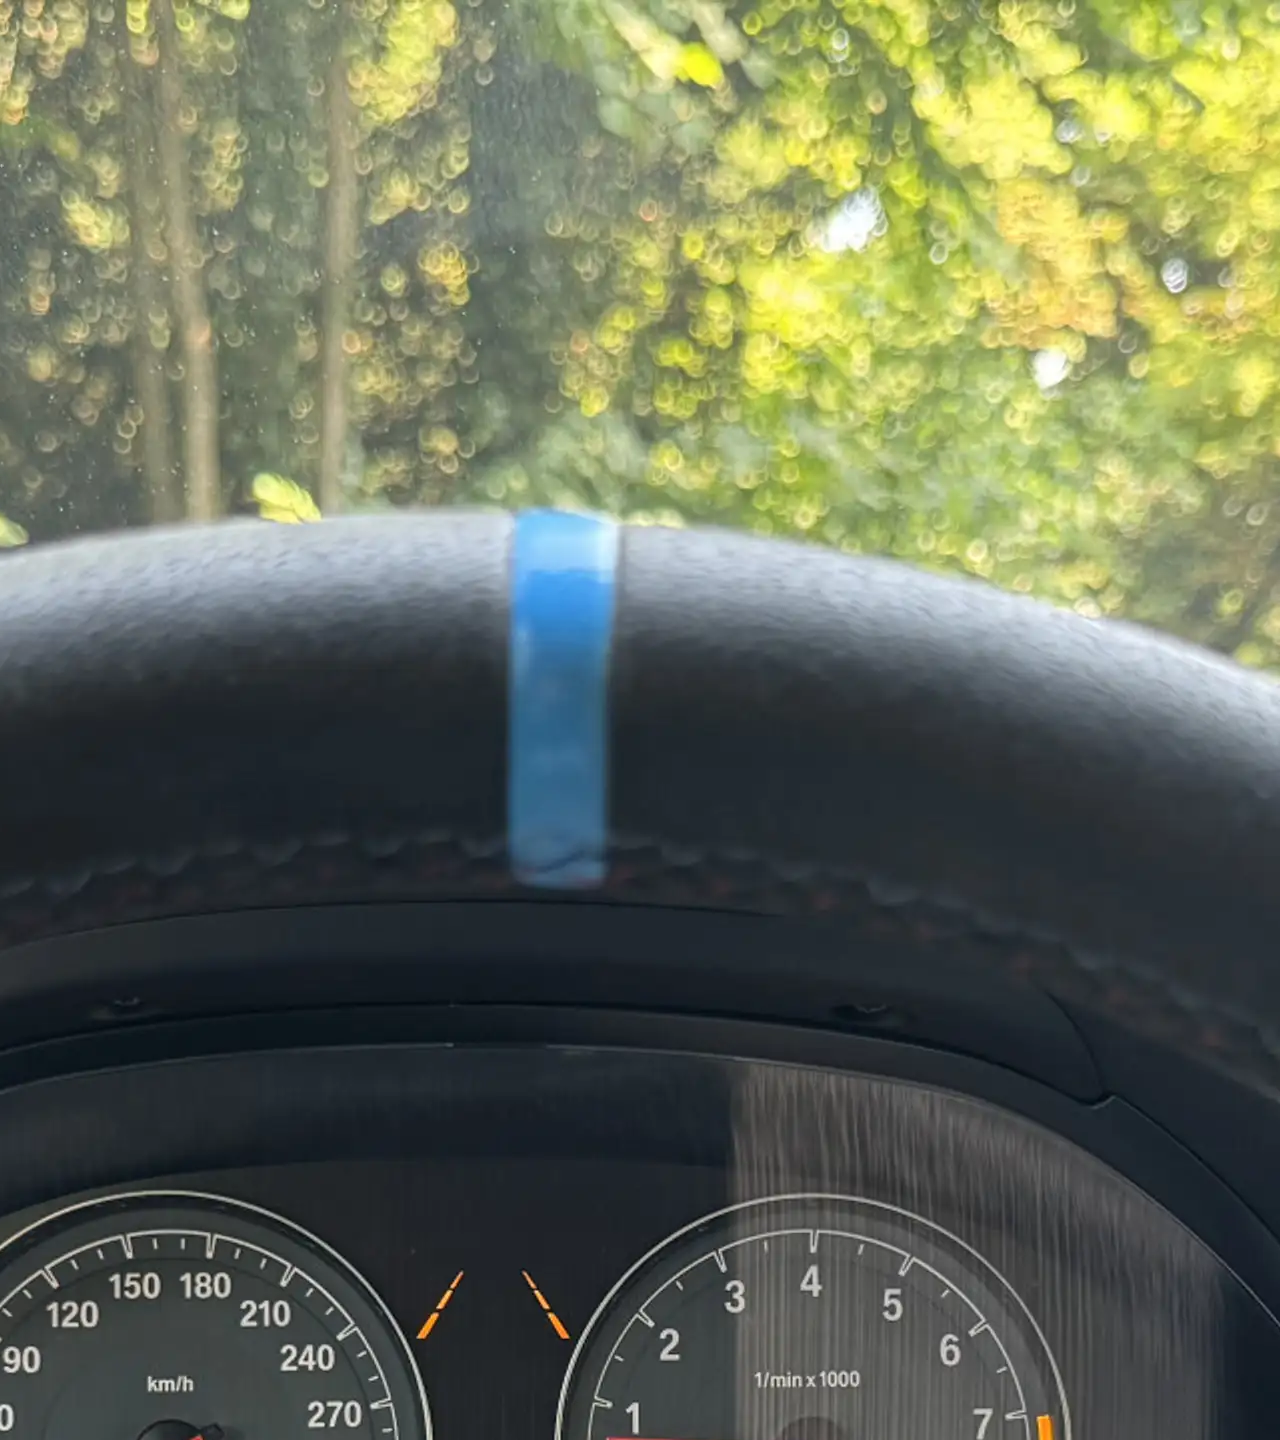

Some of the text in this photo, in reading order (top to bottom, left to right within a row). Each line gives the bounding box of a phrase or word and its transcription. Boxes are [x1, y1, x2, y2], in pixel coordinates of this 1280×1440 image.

[109, 1272, 161, 1299] 150
[179, 1272, 232, 1299] 180
[800, 1265, 822, 1298] 4
[724, 1280, 746, 1314] 3
[882, 1288, 904, 1322] 5
[46, 1301, 99, 1328] 120
[240, 1300, 291, 1327] 210
[280, 1344, 335, 1371] 240
[659, 1328, 681, 1361] 2
[939, 1333, 961, 1367] 6
[2, 1346, 40, 1374] 90
[147, 1375, 194, 1393] km/h
[754, 1371, 802, 1390] 1/min
[820, 1371, 860, 1388] 1000
[307, 1402, 362, 1429] 270
[626, 1402, 641, 1434] 1
[973, 1408, 993, 1440] 7
